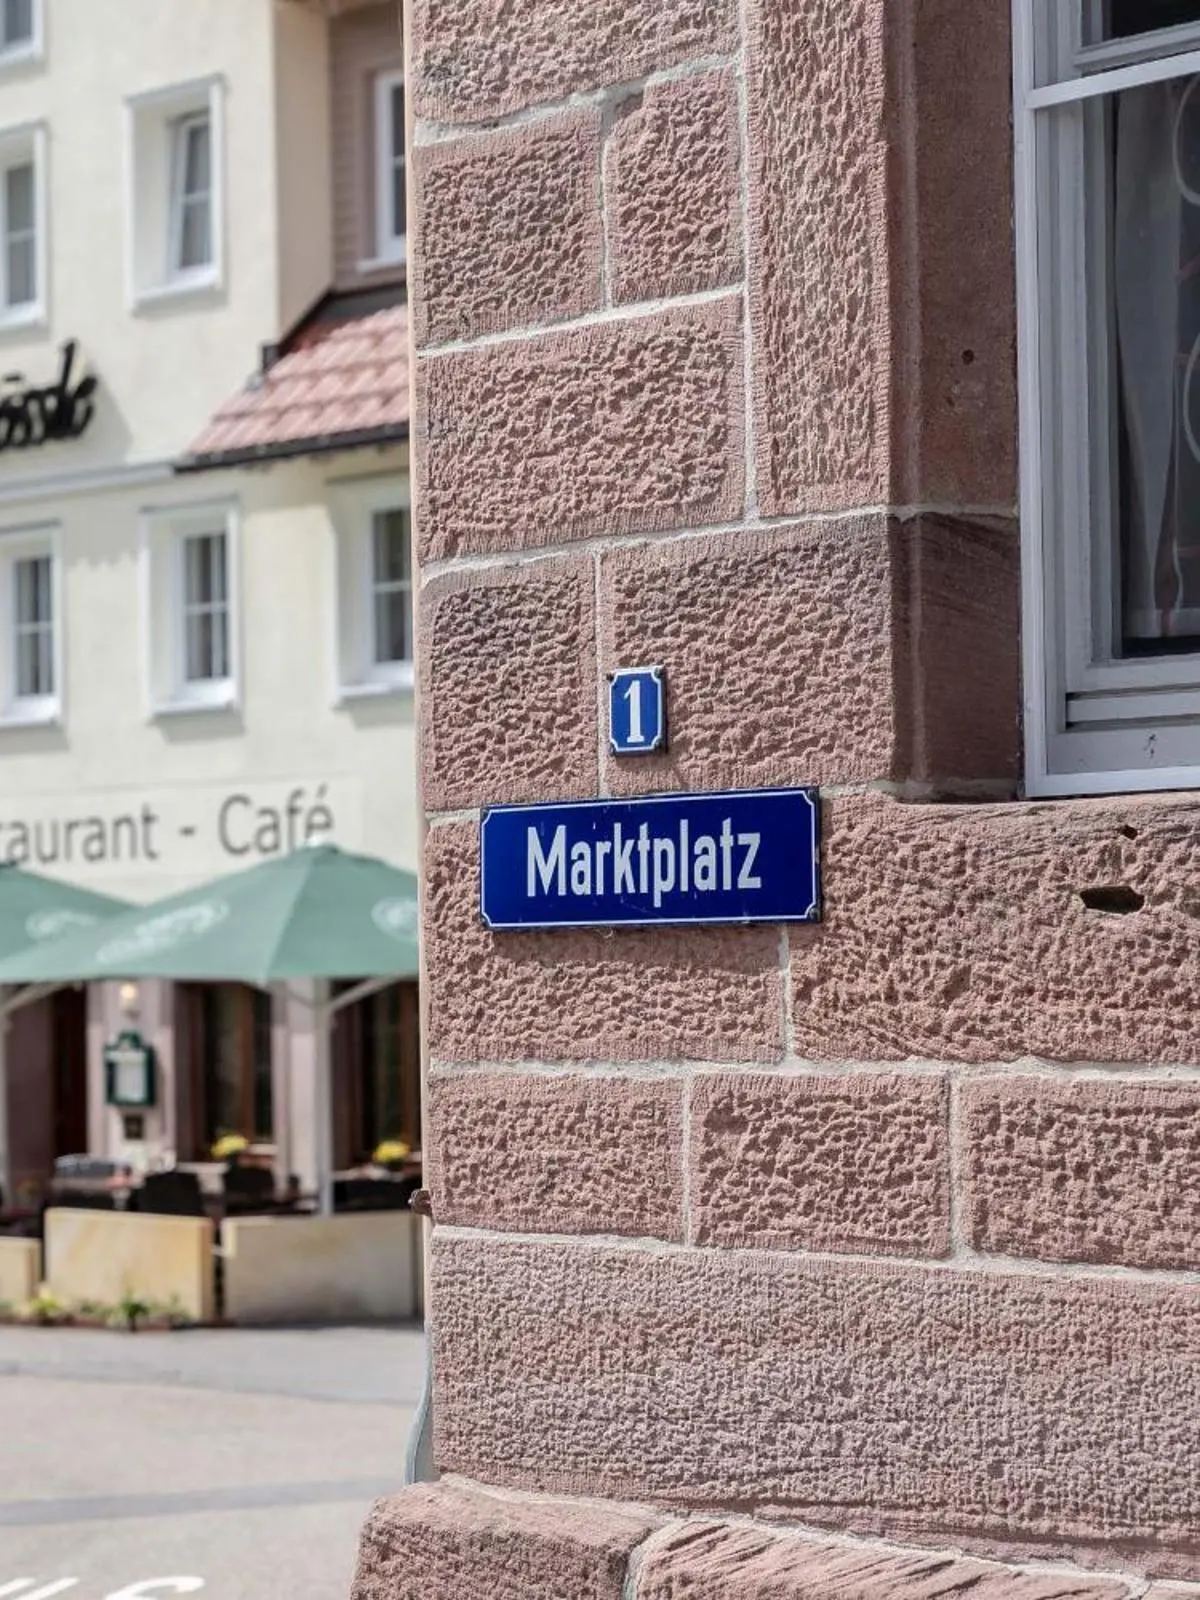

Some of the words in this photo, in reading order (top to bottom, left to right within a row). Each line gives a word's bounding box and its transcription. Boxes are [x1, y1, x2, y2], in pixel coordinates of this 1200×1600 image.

[623, 679, 645, 744] 1
[218, 782, 334, 856] Café
[526, 817, 762, 908] Marktplatz
